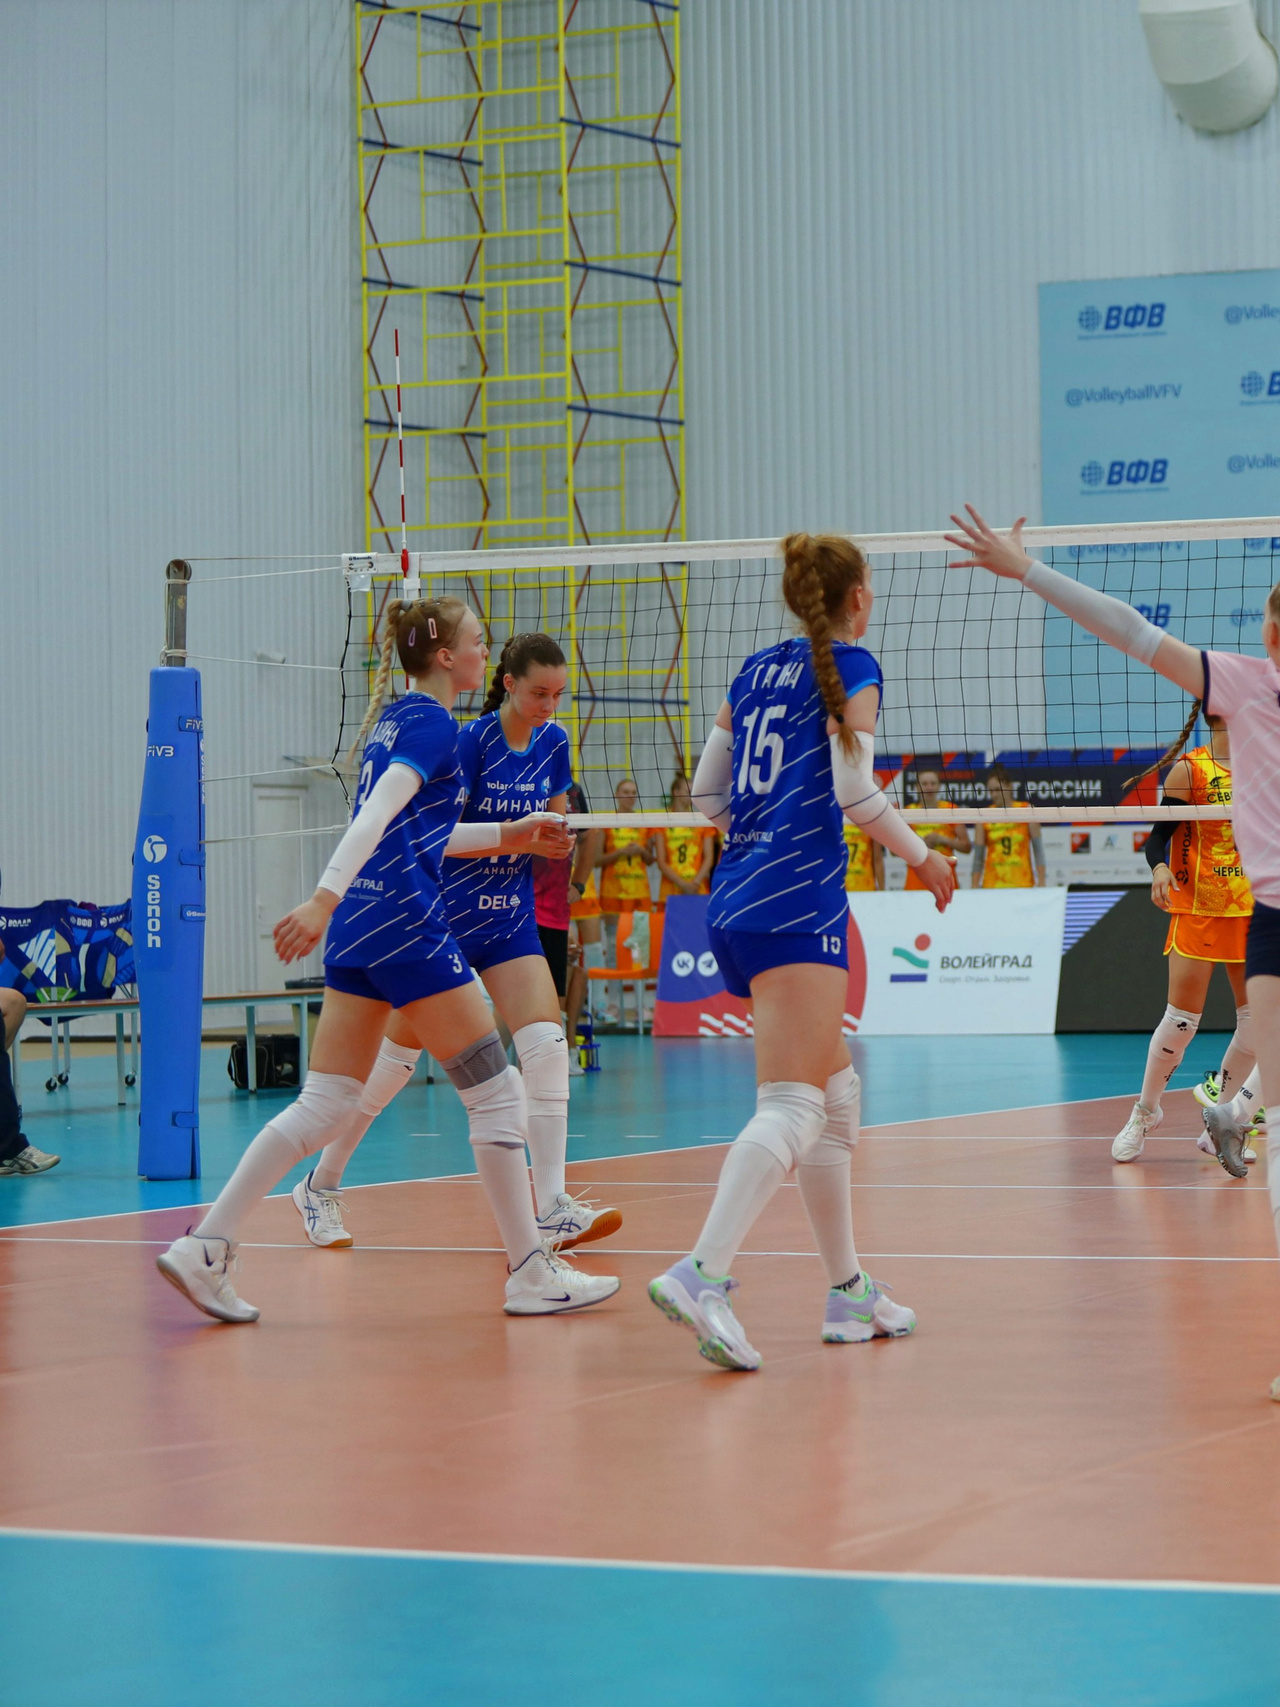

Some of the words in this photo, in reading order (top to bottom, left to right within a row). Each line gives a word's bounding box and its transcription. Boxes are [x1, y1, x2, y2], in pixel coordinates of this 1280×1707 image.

[1104, 303, 1166, 330] ВФВ
[1064, 384, 1182, 408] @VolleyballVFV
[1106, 459, 1168, 486] ВФВ
[738, 704, 788, 795] 15
[1027, 779, 1102, 800] РОССИИ
[678, 843, 688, 864] 8
[1001, 835, 1012, 856] 9
[940, 953, 1033, 970] ВОЛЕЙГРАД
